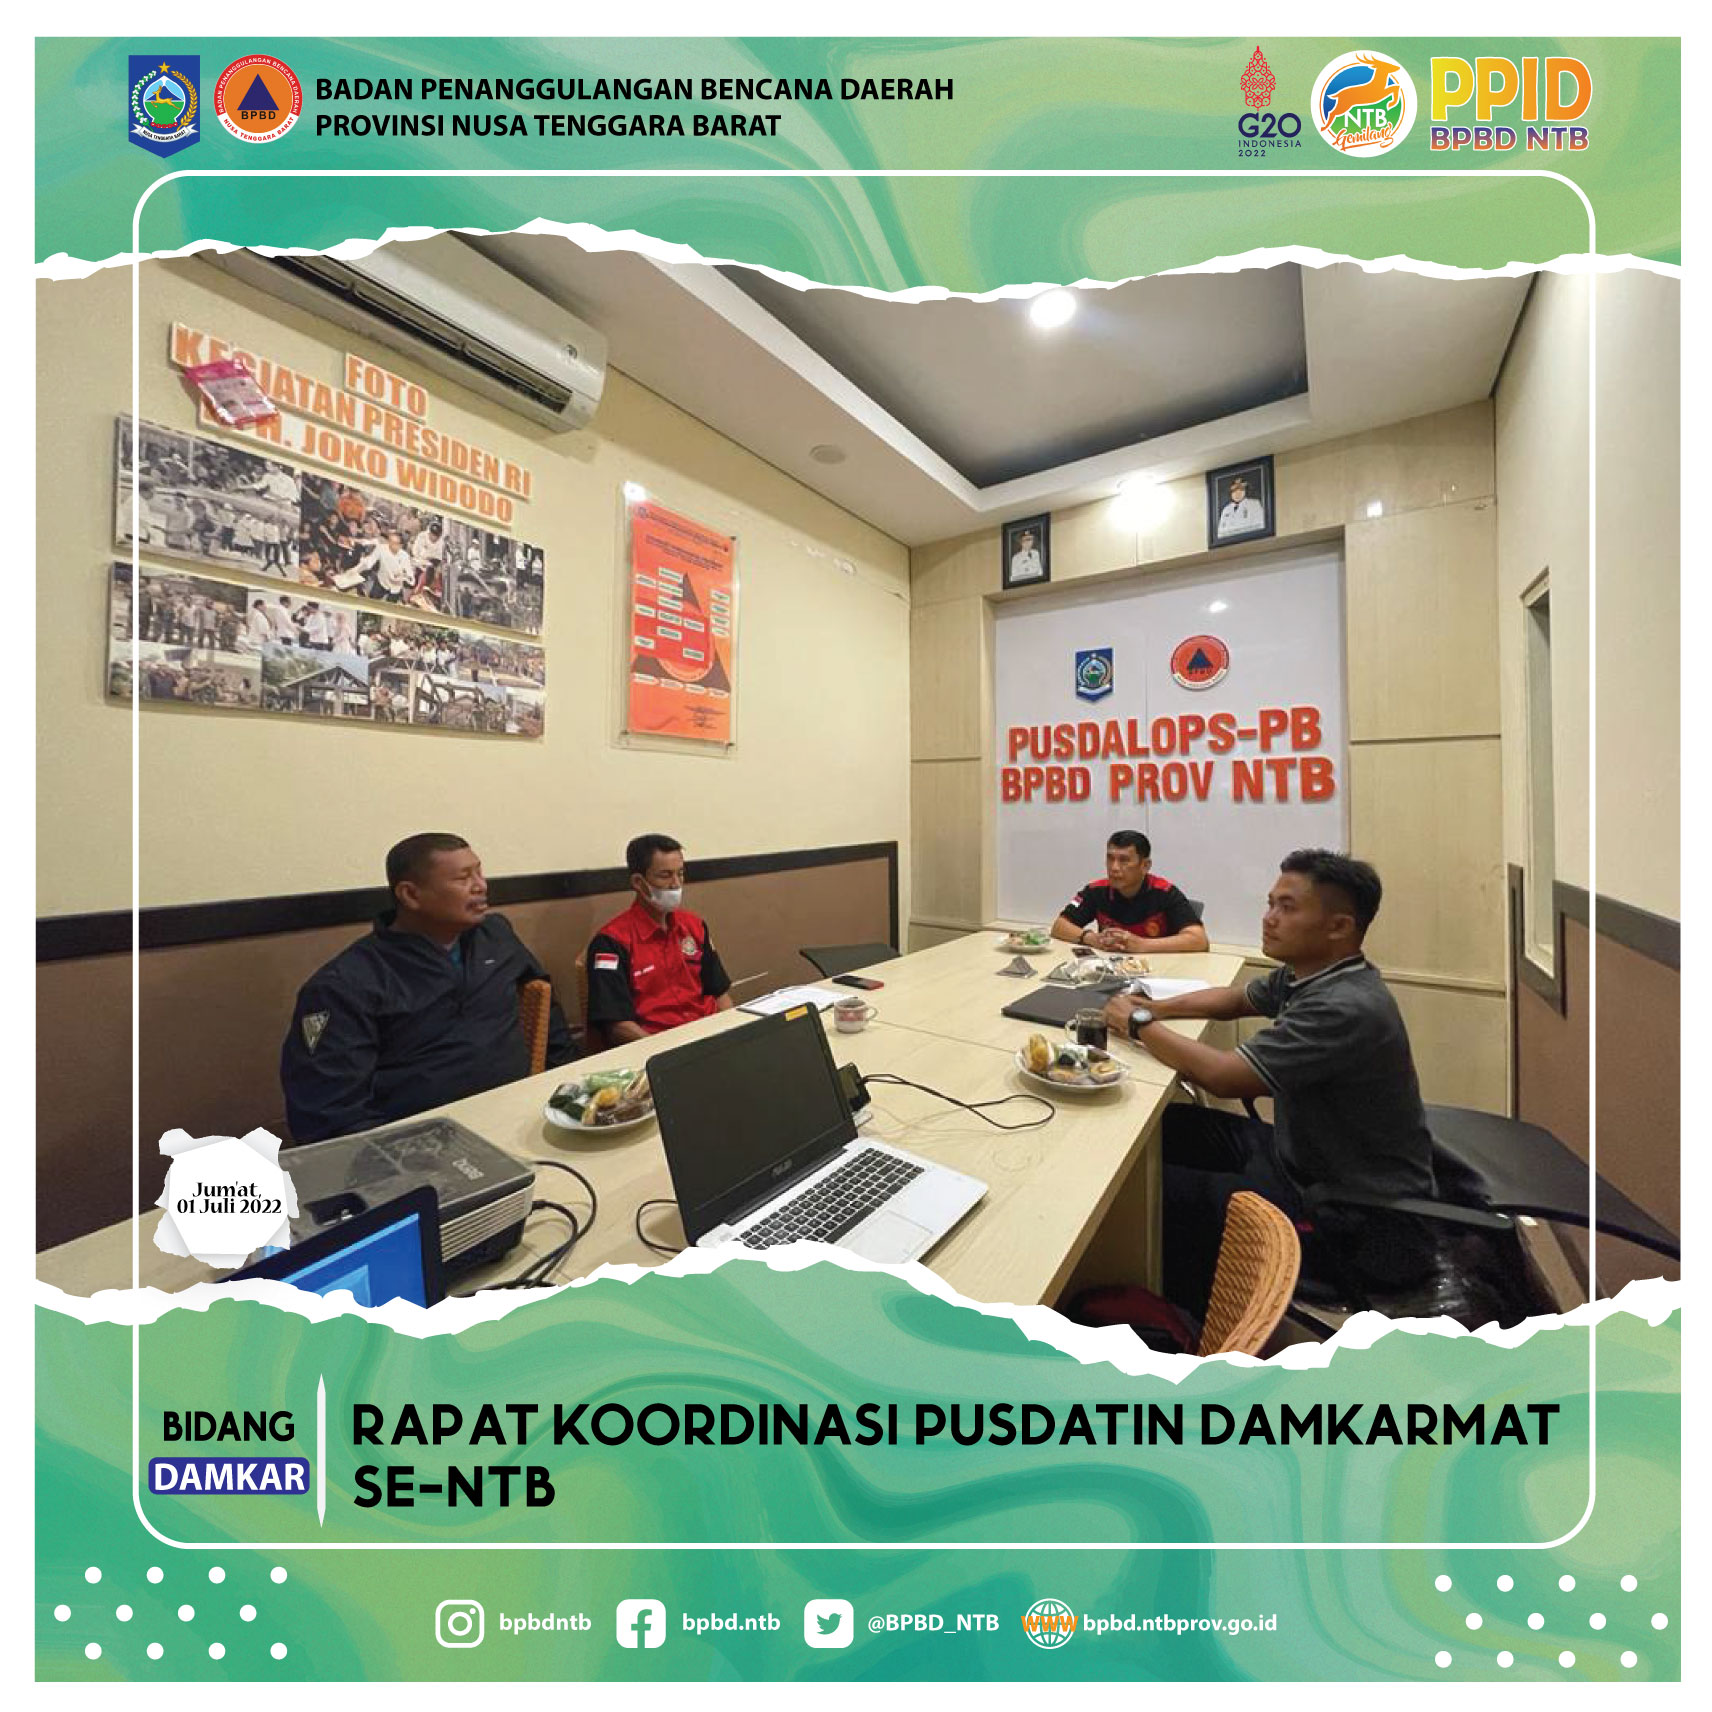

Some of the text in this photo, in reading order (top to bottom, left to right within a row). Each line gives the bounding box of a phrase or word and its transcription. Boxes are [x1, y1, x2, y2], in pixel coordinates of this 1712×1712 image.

[345, 356, 427, 418] FOTO
[301, 424, 387, 479] JOKO
[396, 458, 512, 523] WIDODO
[363, 403, 499, 484] PRESIDEN
[505, 462, 531, 497] RI
[1008, 707, 1322, 762] PUSDALOPS-PB
[1001, 757, 1336, 804] BPBD PROV NTB
